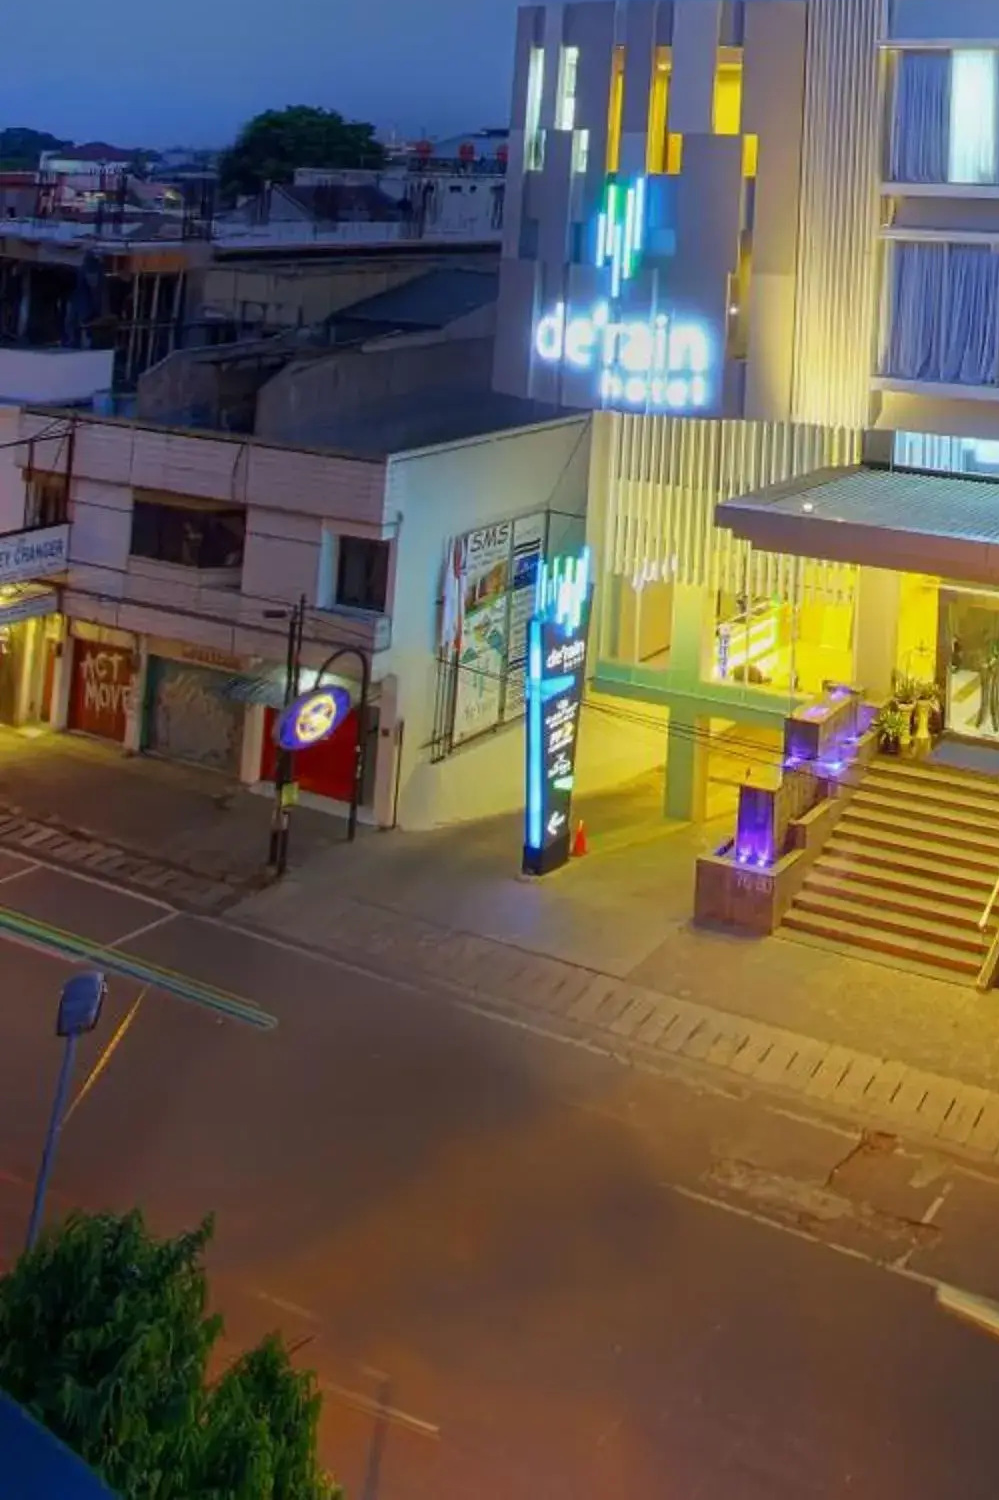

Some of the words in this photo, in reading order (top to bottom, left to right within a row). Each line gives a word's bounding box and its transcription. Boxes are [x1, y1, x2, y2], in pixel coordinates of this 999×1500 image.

[536, 301, 708, 370] de'rain
[601, 369, 705, 405] hotel
[470, 524, 508, 552] SMS
